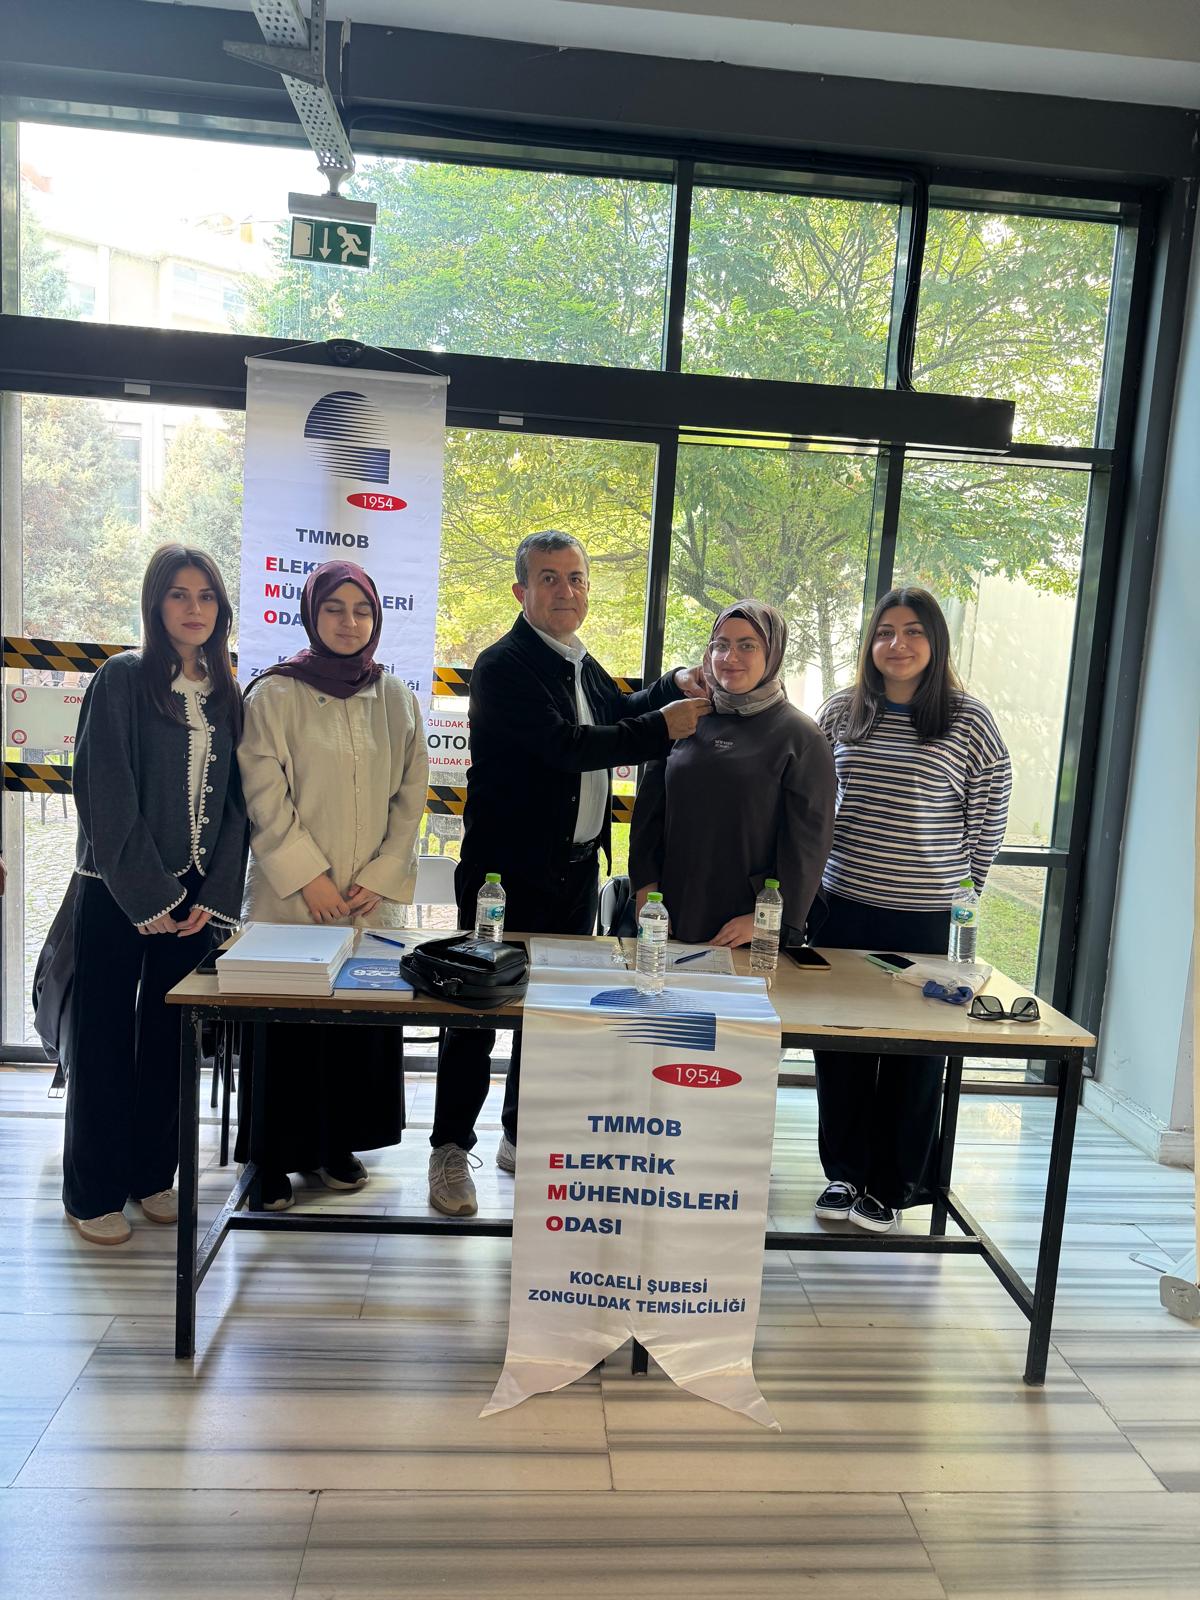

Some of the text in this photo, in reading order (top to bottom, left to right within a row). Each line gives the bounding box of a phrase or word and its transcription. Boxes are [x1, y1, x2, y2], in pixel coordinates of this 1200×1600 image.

[362, 495, 394, 510] 1954
[295, 528, 369, 549] TMMOB
[265, 556, 320, 575] ELEK
[263, 610, 304, 627] ODA
[427, 718, 464, 729] GULDAK
[427, 734, 470, 750] OTO
[675, 1067, 721, 1085] 1954
[587, 1115, 682, 1137] TMMOB
[549, 1152, 676, 1175] ELEKTRİK
[547, 1181, 739, 1211] MÜHENDİSLERİ
[546, 1215, 622, 1235] ODASI
[569, 1271, 708, 1295] KOCAELİ ŞUBESİ
[528, 1289, 746, 1314] ZONGULDAK TEMSİLCİLİĞİ
